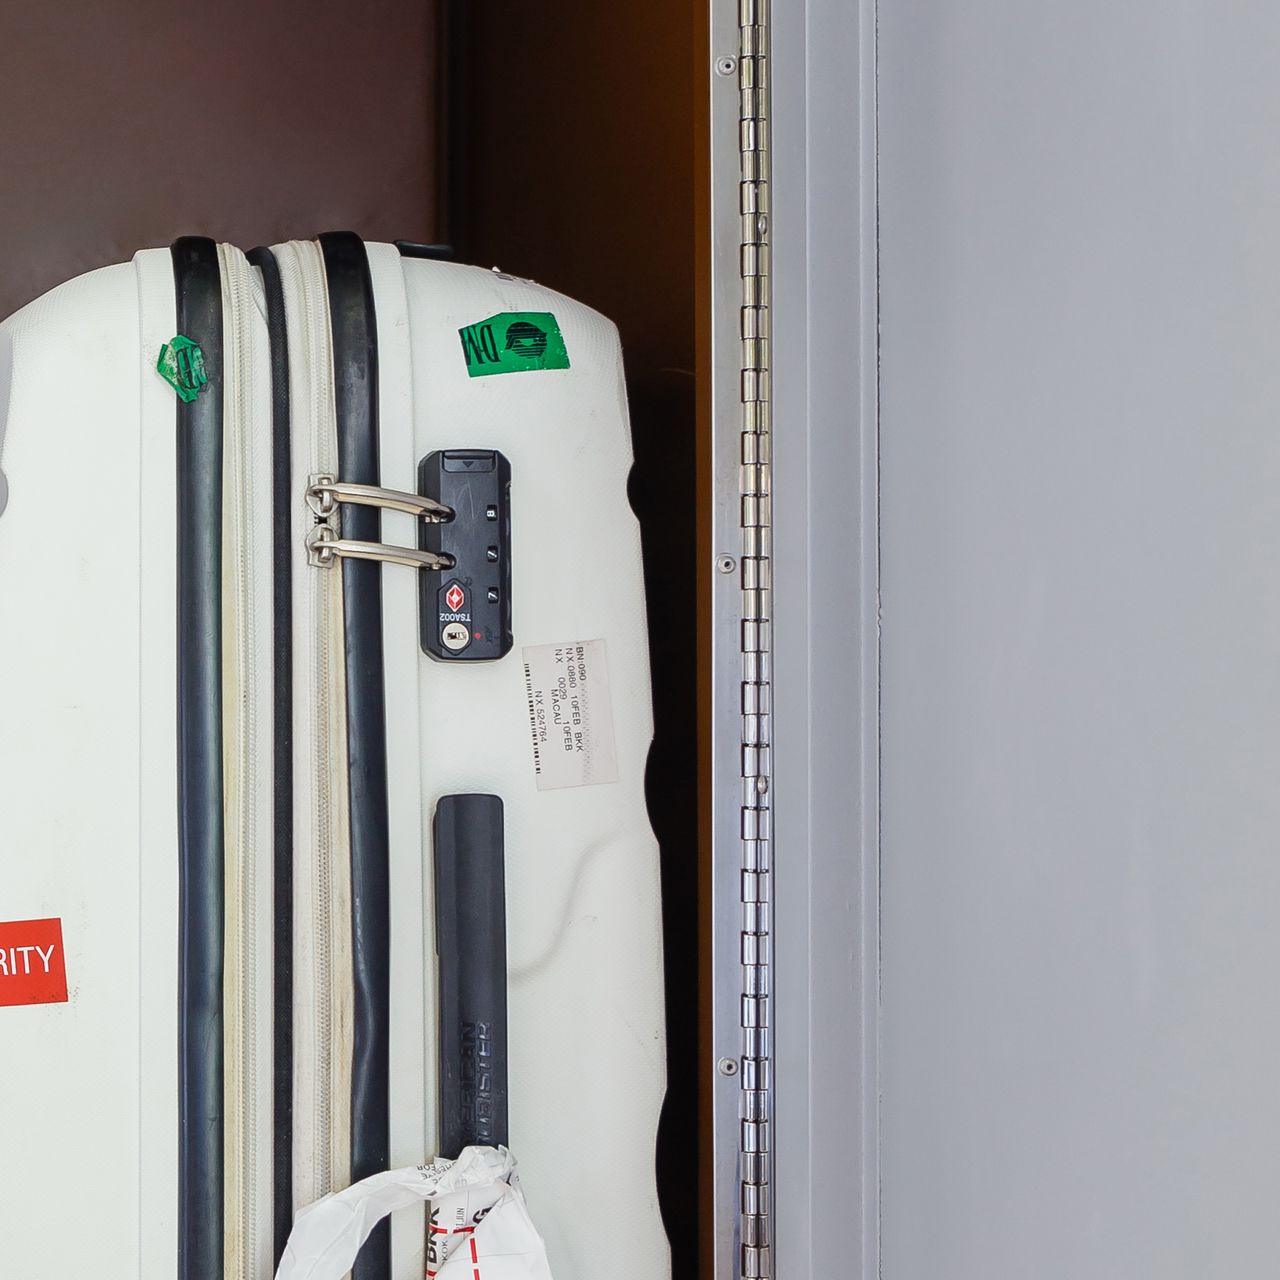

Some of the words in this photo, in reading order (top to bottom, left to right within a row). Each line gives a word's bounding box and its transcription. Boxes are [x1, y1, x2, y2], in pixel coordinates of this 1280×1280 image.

[439, 612, 472, 622] TSA002
[555, 648, 564, 664] NX
[535, 690, 544, 706] NX
[557, 676, 568, 700] 0029
[551, 688, 562, 725] MACAU
[570, 695, 581, 726] 10FEB
[562, 720, 573, 752] 10FEB
[574, 732, 584, 753] BKK
